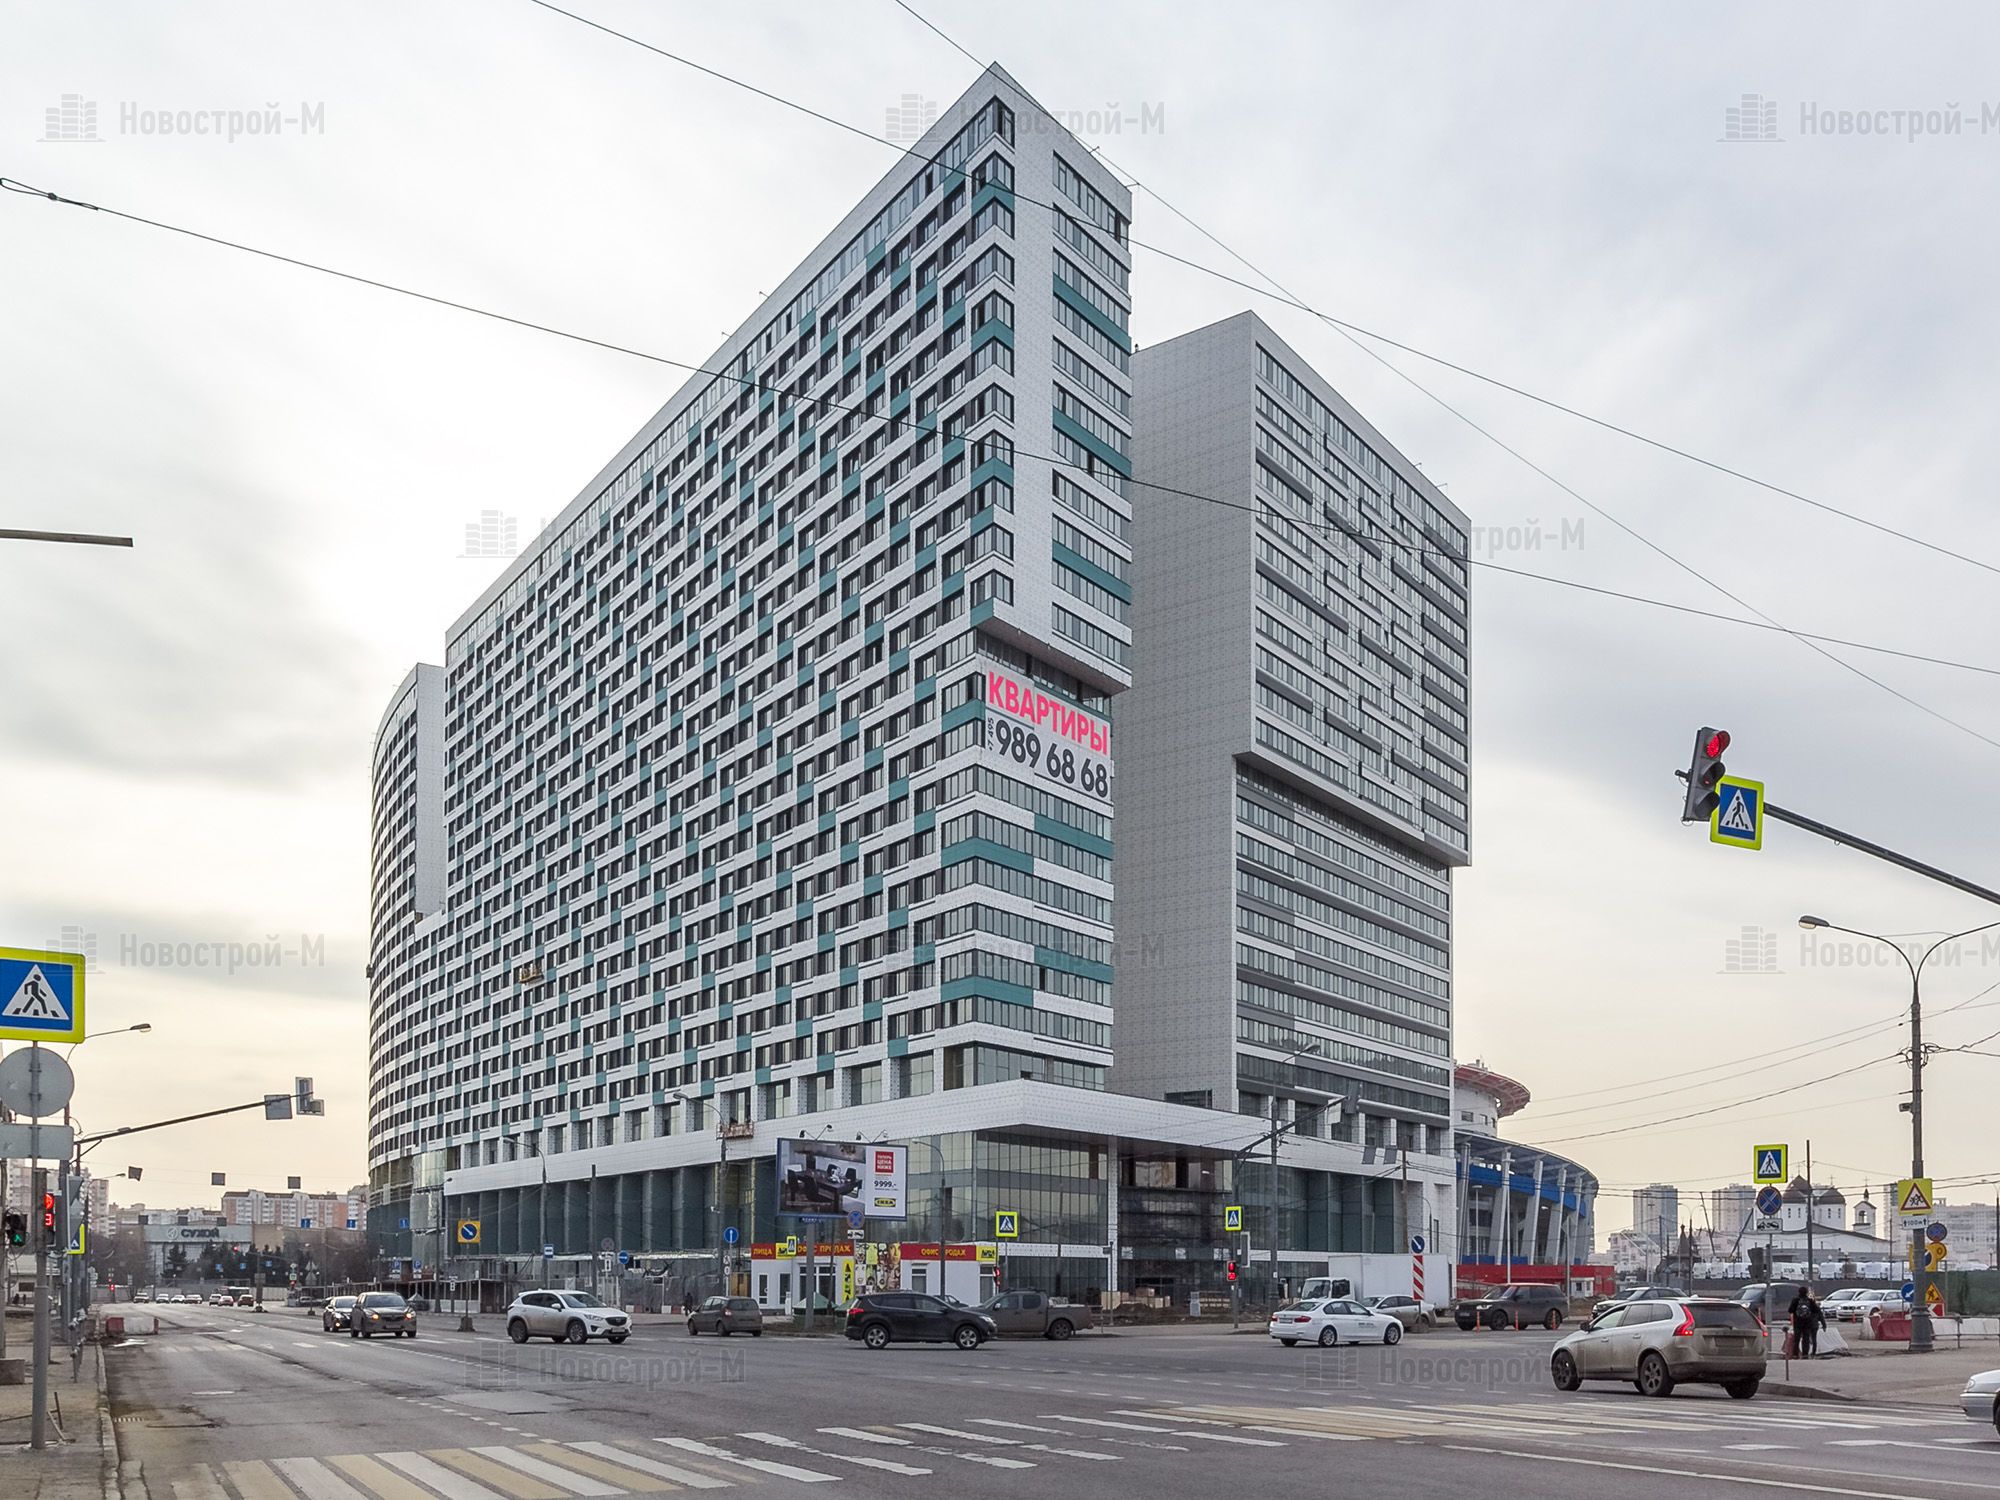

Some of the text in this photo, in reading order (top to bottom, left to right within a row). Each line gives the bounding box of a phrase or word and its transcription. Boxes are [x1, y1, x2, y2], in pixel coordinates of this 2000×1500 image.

[989, 671, 1107, 755] КВАРТИРЫ
[995, 719, 1108, 798] 989 68 68
[45, 1213, 52, 1226] 3
[797, 1245, 818, 1254] ОФС
[819, 1244, 851, 1256] ПРДАЖ
[943, 1248, 967, 1257] РОДАЖ
